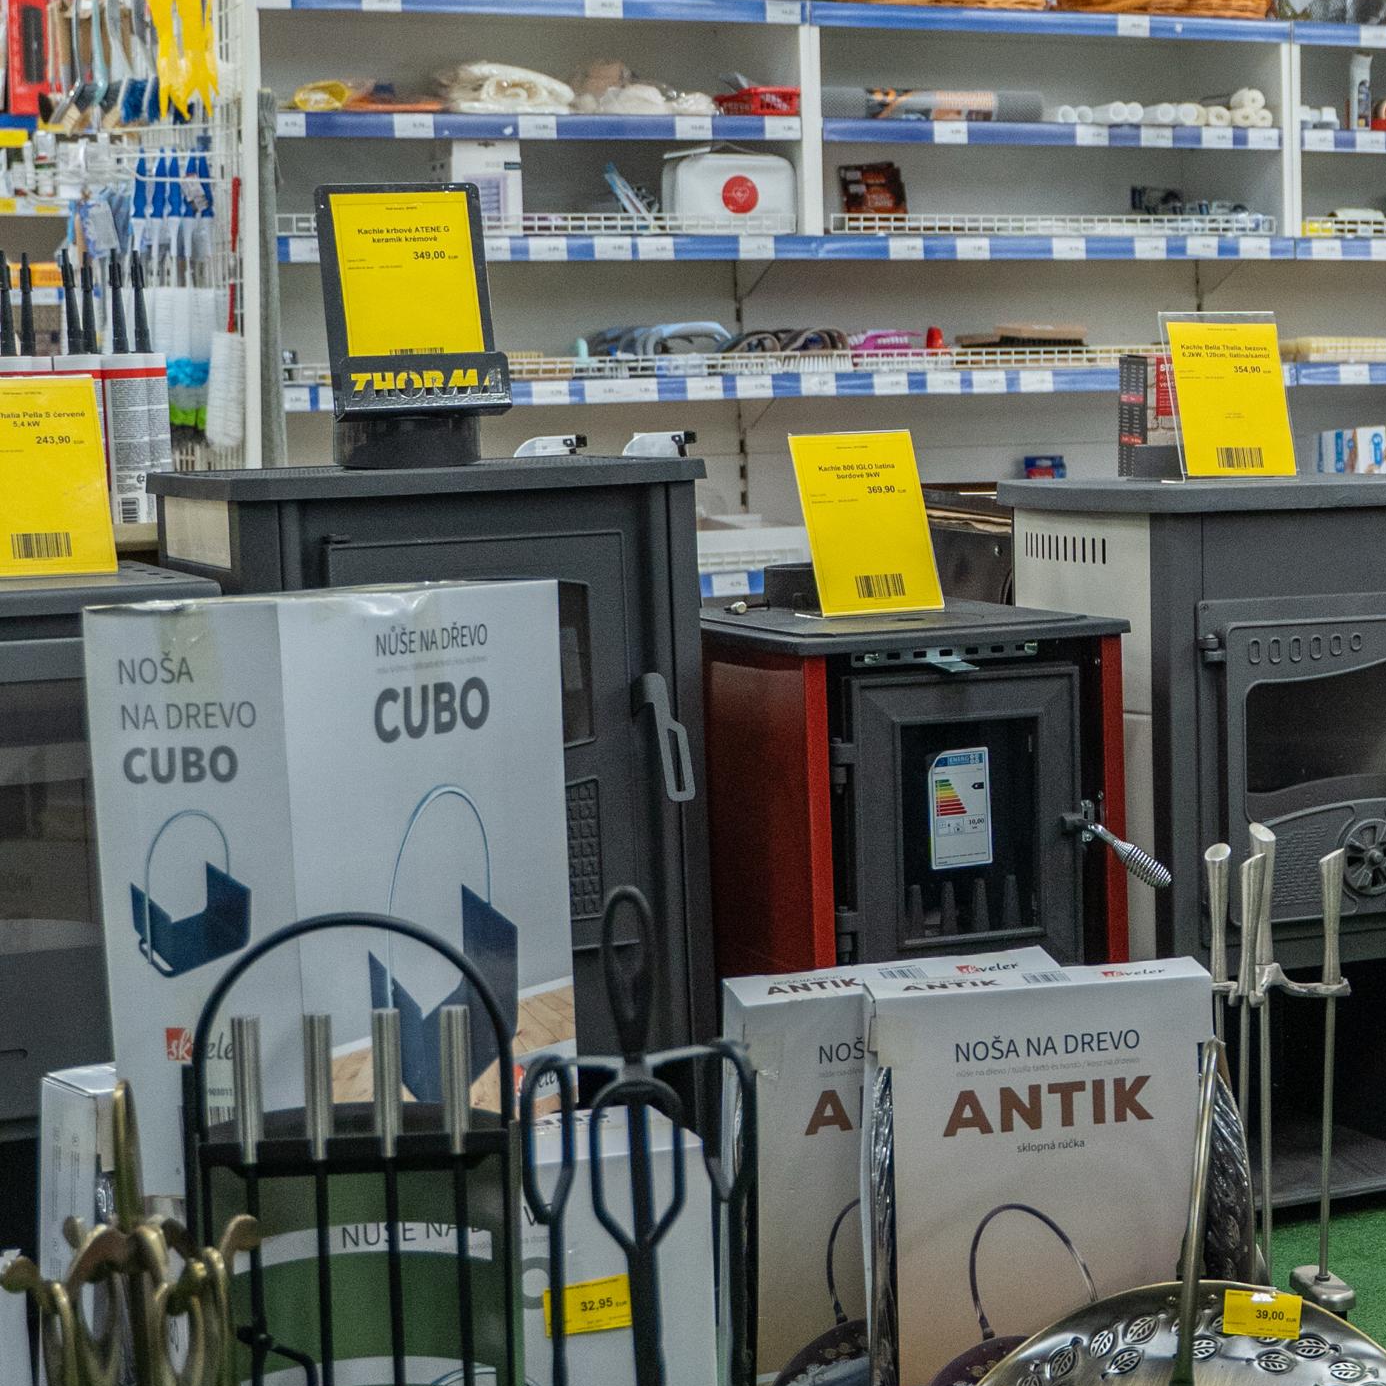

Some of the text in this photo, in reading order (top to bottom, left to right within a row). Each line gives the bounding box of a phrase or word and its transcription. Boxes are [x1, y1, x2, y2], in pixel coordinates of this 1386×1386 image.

[357, 225, 450, 236] Kachle krbové ATENE G
[372, 235, 403, 244] keramik
[413, 250, 446, 262] 349,00
[1233, 365, 1261, 374] 354,90
[349, 368, 504, 400] THORMA
[27, 420, 41, 428] kW
[35, 435, 71, 445] 243,90
[856, 463, 873, 471] IGLO
[867, 485, 896, 494] 369,90
[376, 621, 488, 657] NŮŠE NA DŘEVO
[118, 651, 193, 686] NOŠA
[120, 699, 256, 730] NA DREVO
[373, 676, 490, 744] CUBO
[122, 744, 239, 785] CUBO
[767, 977, 863, 996] ANTIK
[902, 979, 1002, 992] ANTIK
[819, 1036, 865, 1065] NOŠ
[955, 1029, 1141, 1063] NOŠA NA DREVO
[943, 1074, 1154, 1138] ANTIK
[1017, 1138, 1085, 1154] sklopná rúčka
[580, 1296, 614, 1312] 32,95
[1255, 1309, 1285, 1321] 39,00
